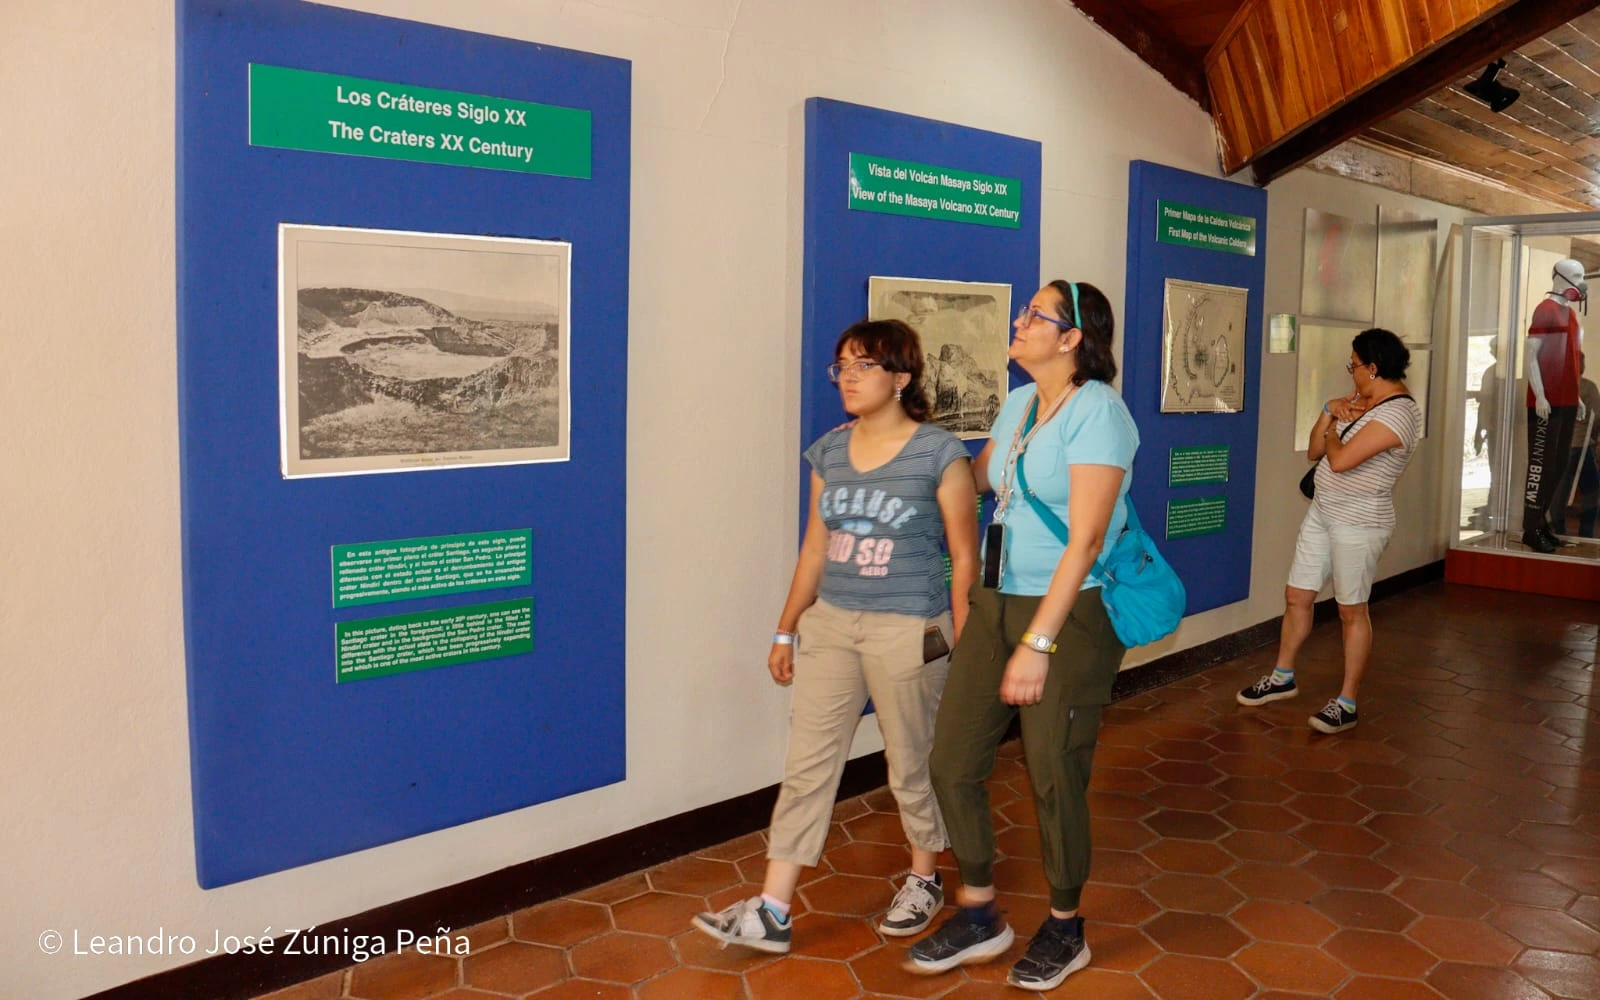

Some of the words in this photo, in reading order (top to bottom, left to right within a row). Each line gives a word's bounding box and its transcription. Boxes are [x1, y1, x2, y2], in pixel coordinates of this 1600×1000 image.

[336, 86, 371, 106] Los
[377, 92, 452, 116] Cráteres
[458, 102, 499, 124] Siglo
[505, 109, 527, 126] XX
[328, 120, 364, 140] The
[370, 126, 435, 148] Craters
[440, 134, 464, 151] XX
[469, 137, 534, 163] Century
[868, 163, 891, 178] Vista
[894, 168, 906, 179] del
[909, 170, 938, 184] Volcán
[941, 174, 971, 192] Masaya
[973, 180, 993, 195] Siglo
[994, 183, 1008, 195] XIX
[852, 186, 875, 200] View
[877, 191, 888, 202] of
[889, 192, 902, 204] the
[905, 194, 938, 211] Masaya
[940, 198, 972, 213] Volcano
[974, 203, 987, 216] XIX
[989, 205, 1019, 222] Century
